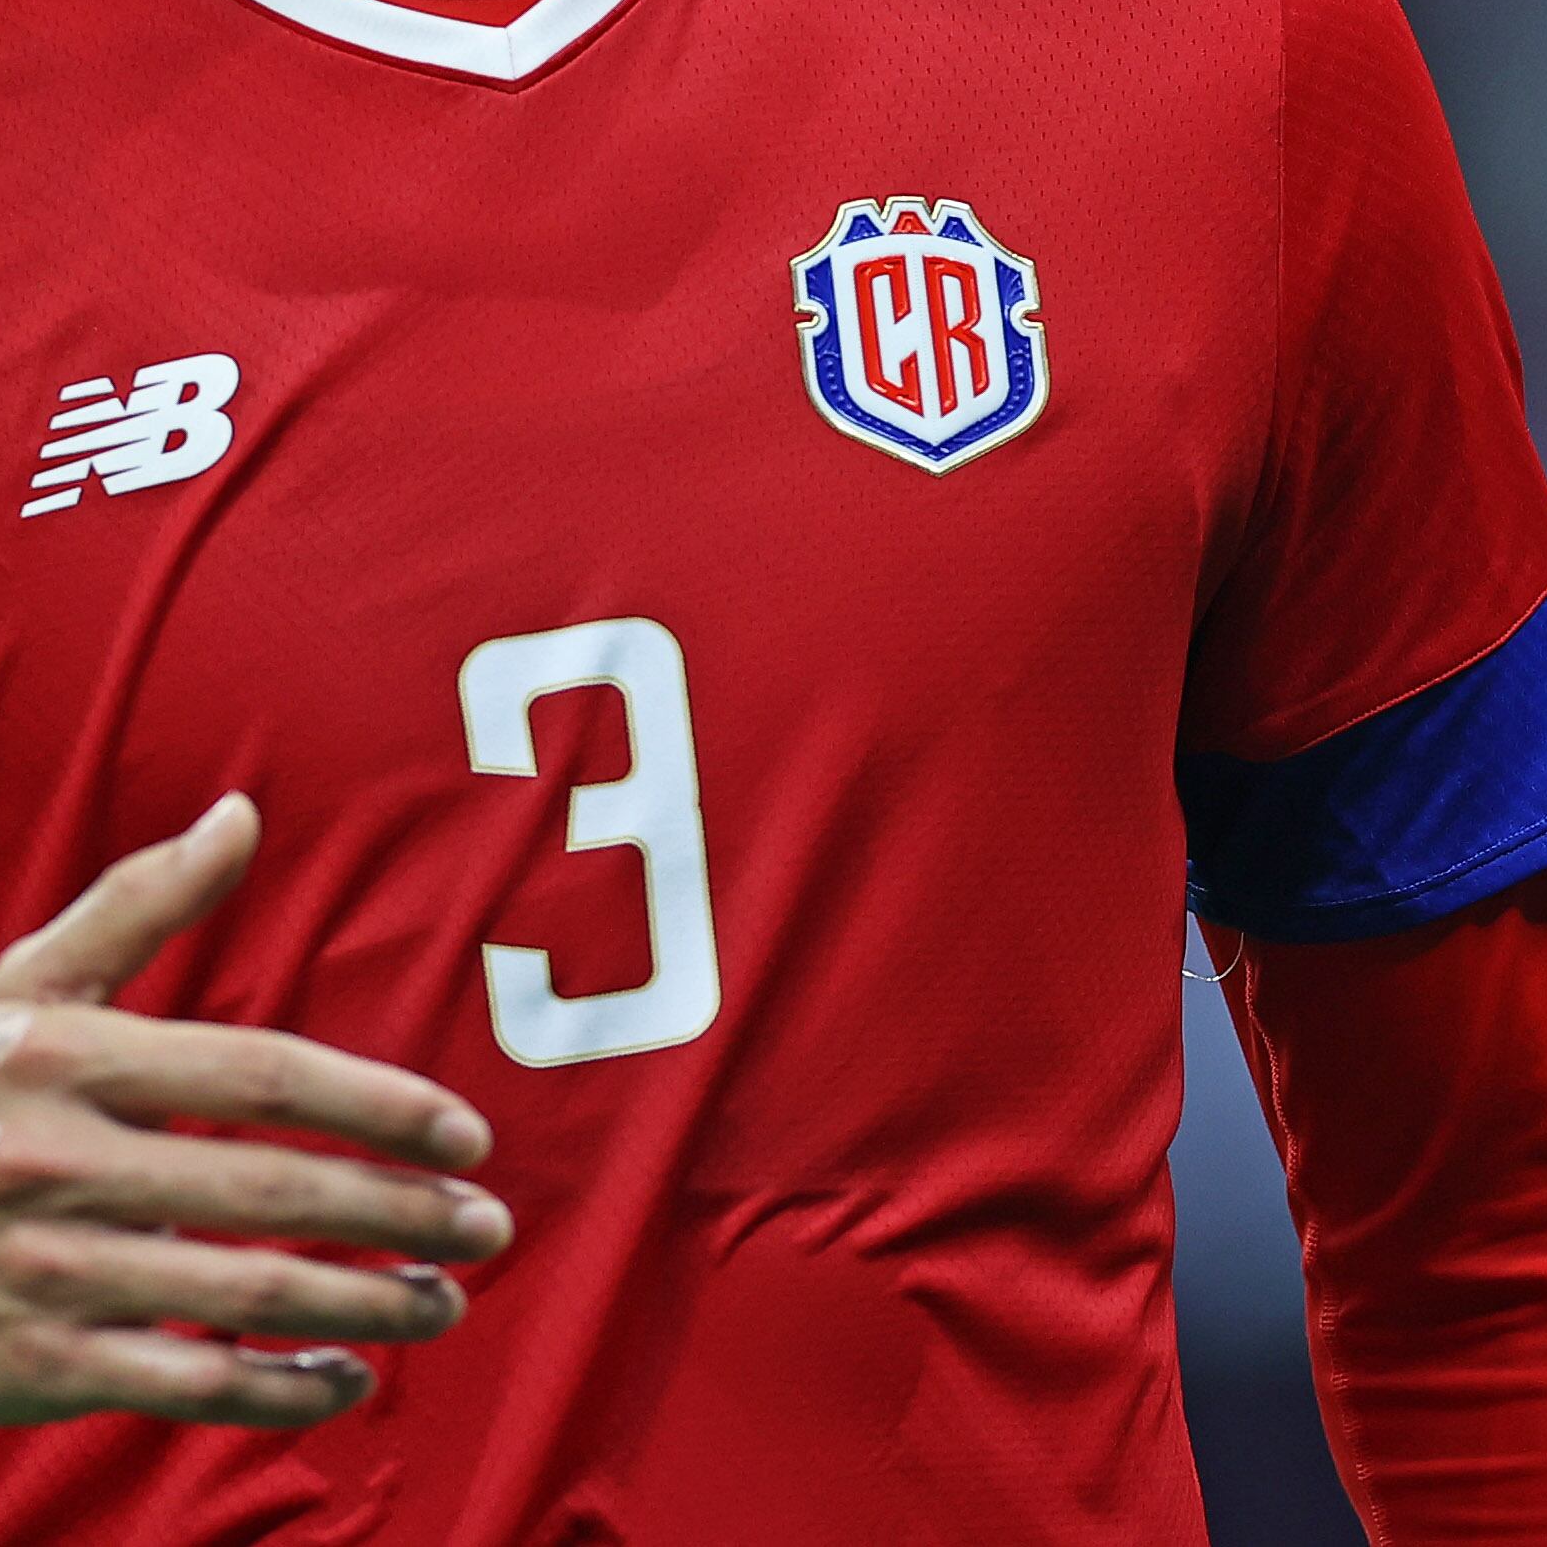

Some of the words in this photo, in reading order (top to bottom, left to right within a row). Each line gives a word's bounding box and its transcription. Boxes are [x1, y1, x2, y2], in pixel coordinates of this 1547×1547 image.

[853, 254, 990, 419] CR
[19, 352, 241, 519] NB
[457, 616, 722, 1070] 3
